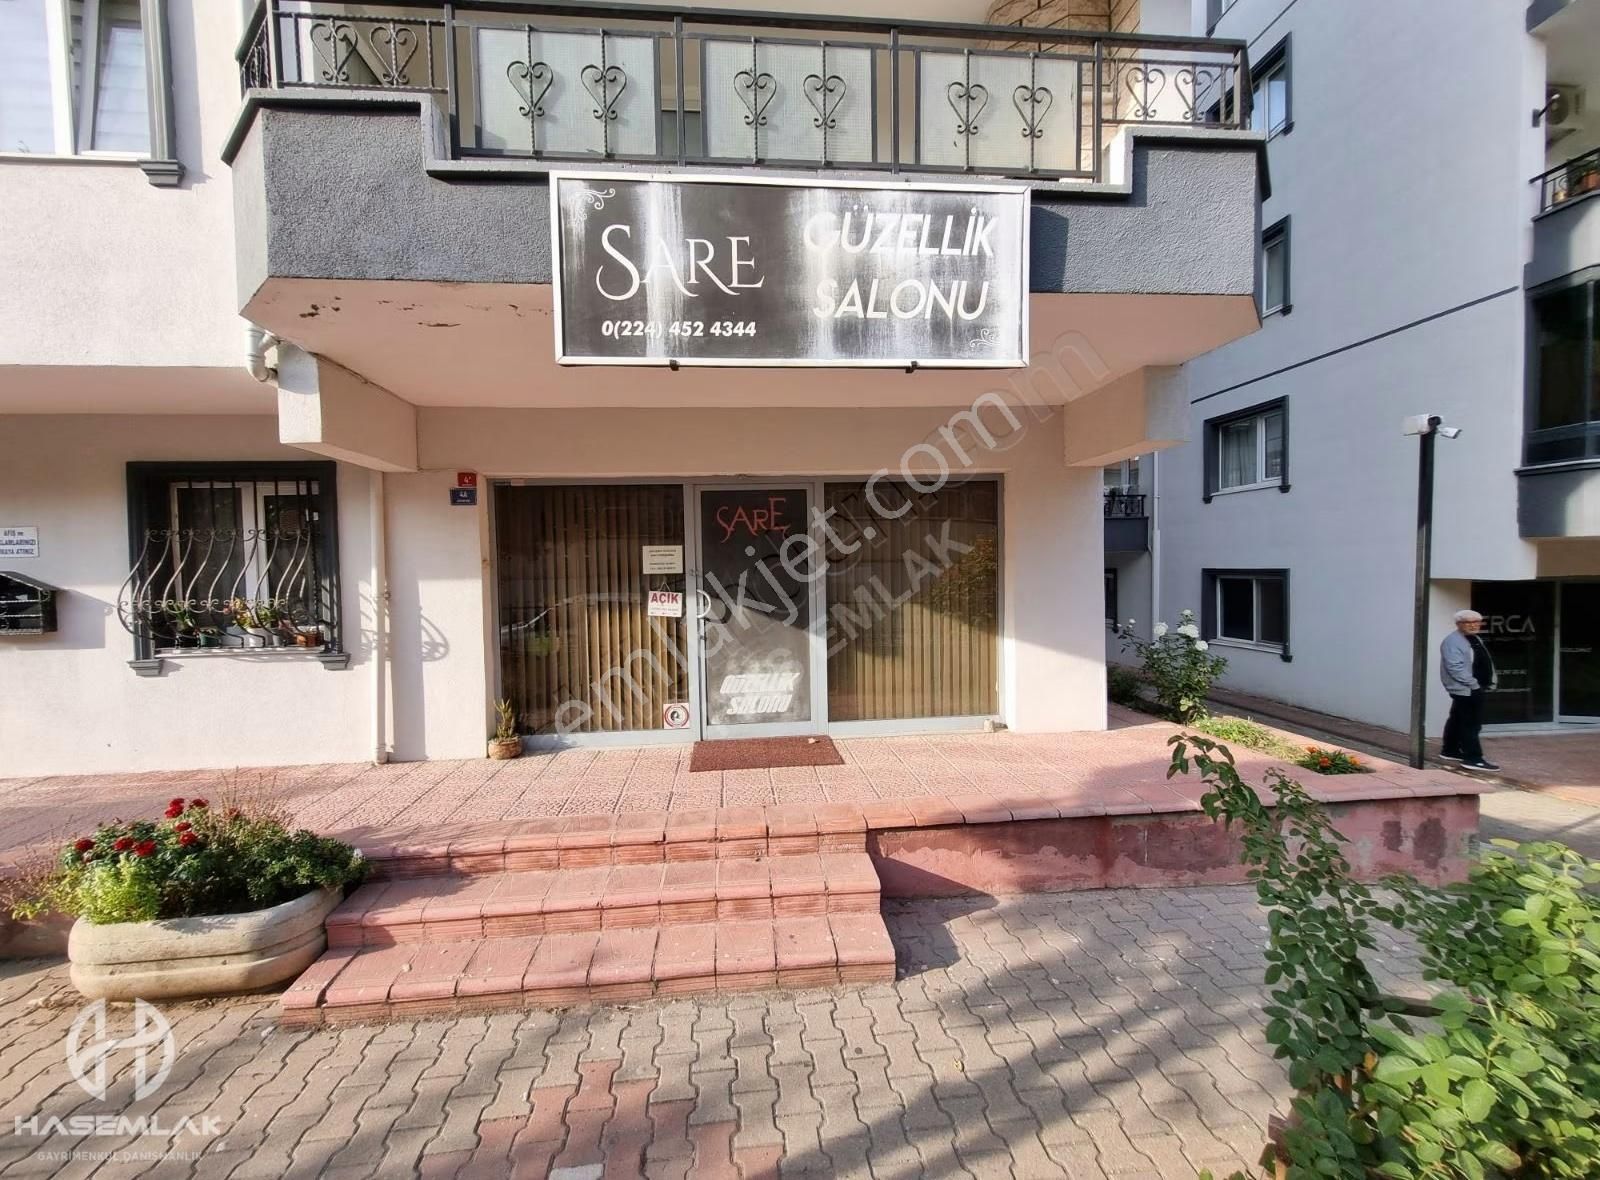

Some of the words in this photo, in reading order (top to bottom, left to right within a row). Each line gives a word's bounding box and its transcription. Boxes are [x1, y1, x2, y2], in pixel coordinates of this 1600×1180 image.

[803, 206, 998, 257] GÜZELLİK
[595, 223, 765, 301] SARE
[813, 278, 989, 320] SALONU
[601, 320, 663, 340] 0(224)
[668, 321, 704, 337] 452
[709, 321, 757, 337] 4344
[716, 496, 790, 543] SARE
